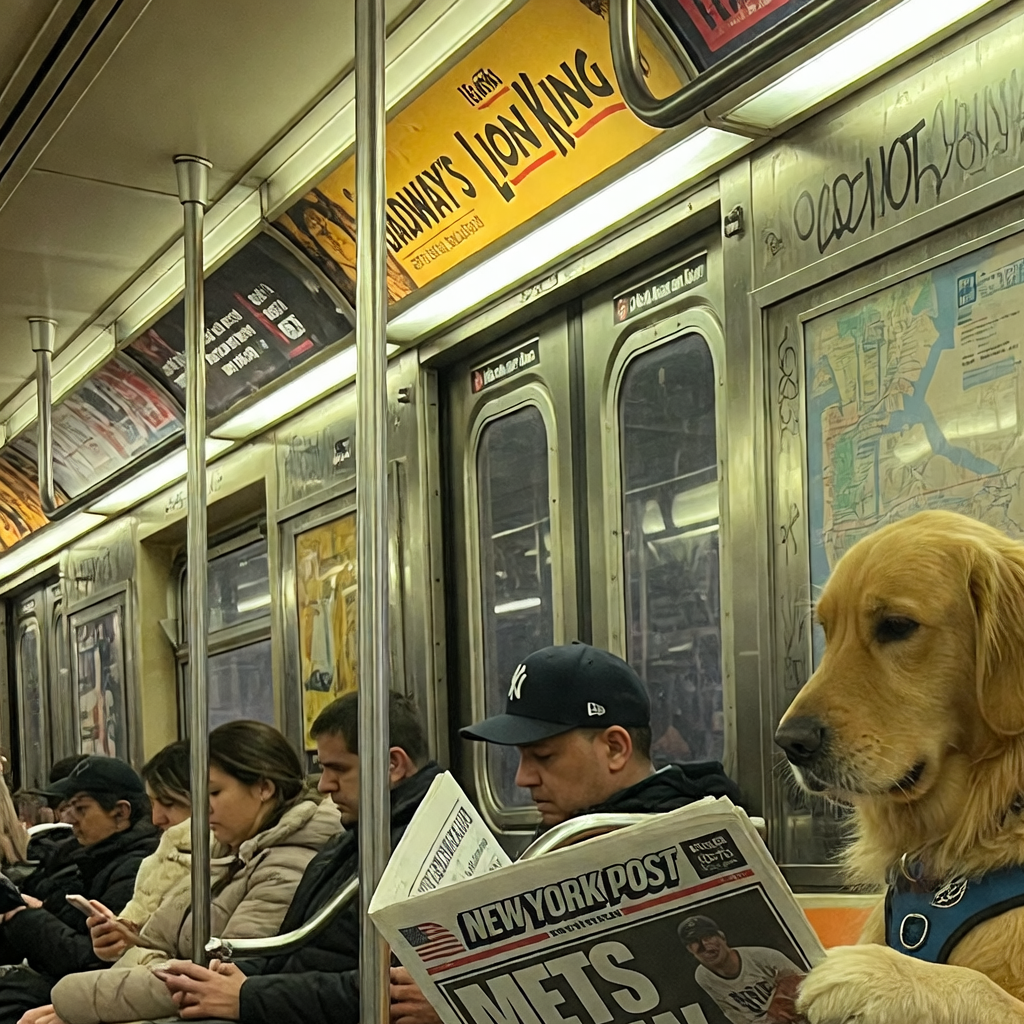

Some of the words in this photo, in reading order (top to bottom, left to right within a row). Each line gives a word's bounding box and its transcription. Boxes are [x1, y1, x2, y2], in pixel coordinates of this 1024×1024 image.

[454, 104, 543, 203] LION
[511, 48, 615, 157] KING
[460, 895, 526, 945] NEW
[524, 870, 605, 926] YORK
[602, 847, 680, 905] POST
